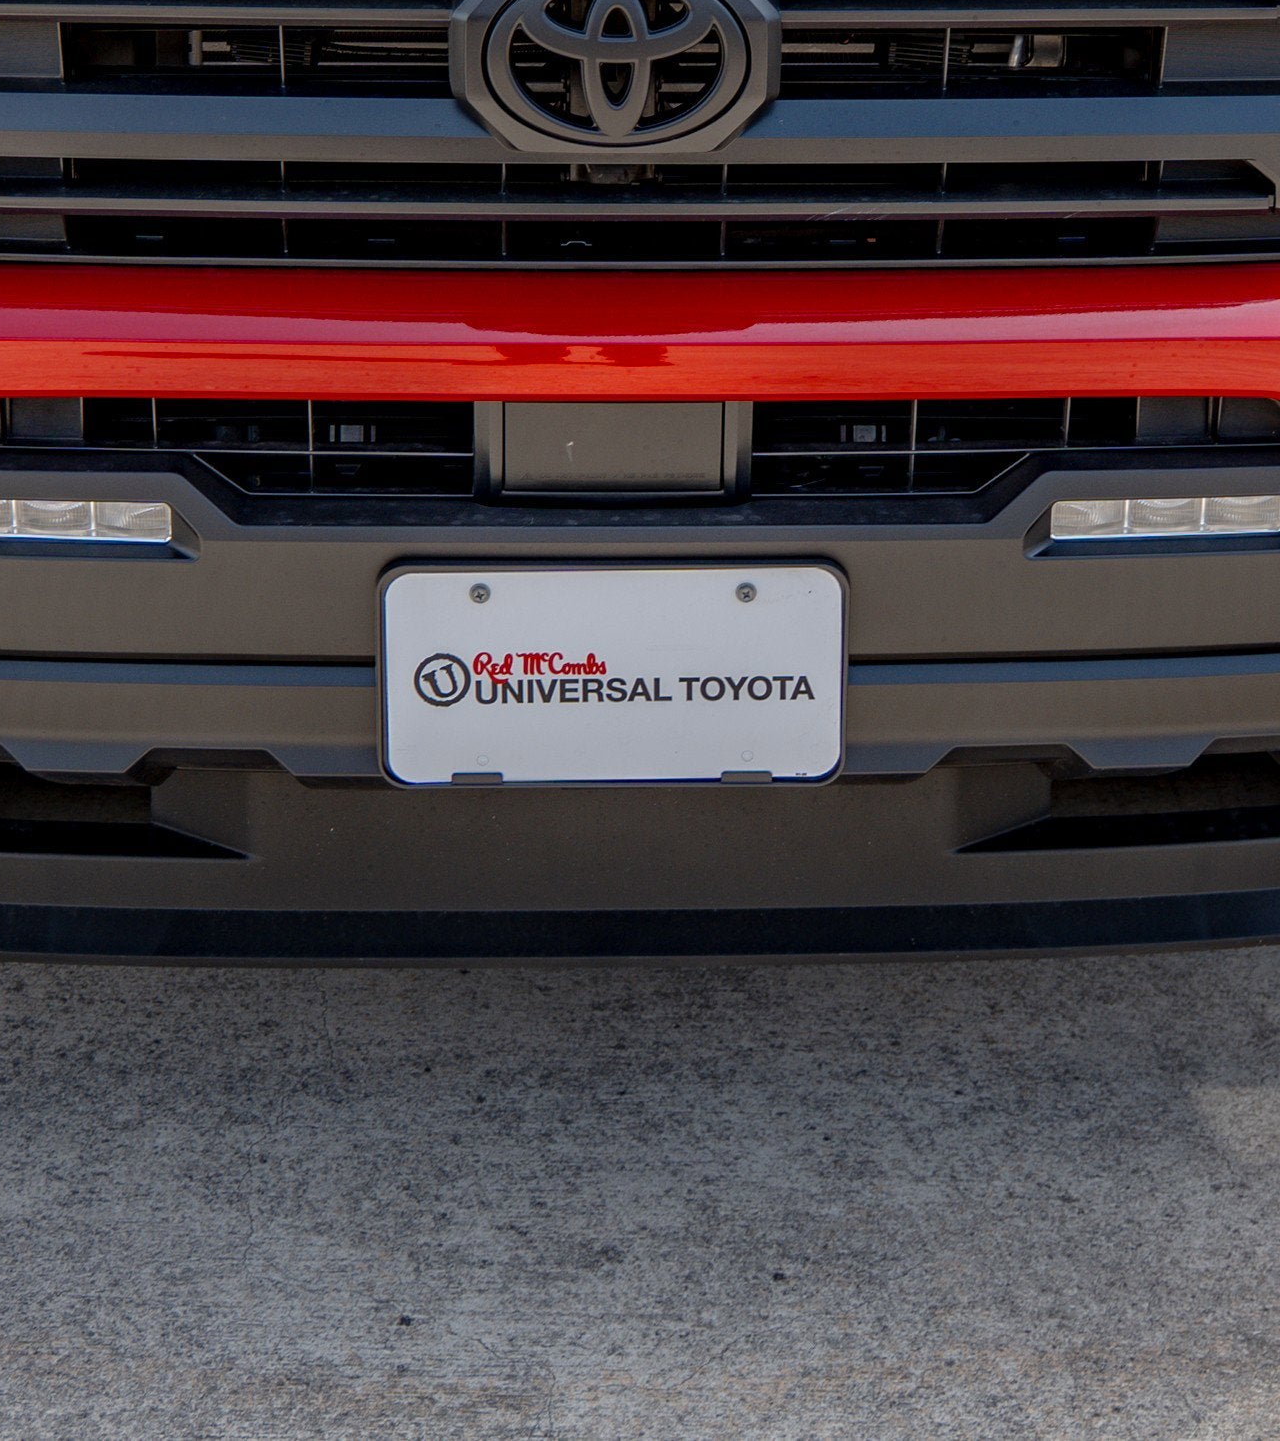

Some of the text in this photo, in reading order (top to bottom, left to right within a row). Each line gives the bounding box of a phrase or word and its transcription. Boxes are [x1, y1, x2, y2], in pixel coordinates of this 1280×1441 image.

[472, 651, 514, 685] Red
[476, 675, 816, 705] UNIVERSAL TOYOTA
